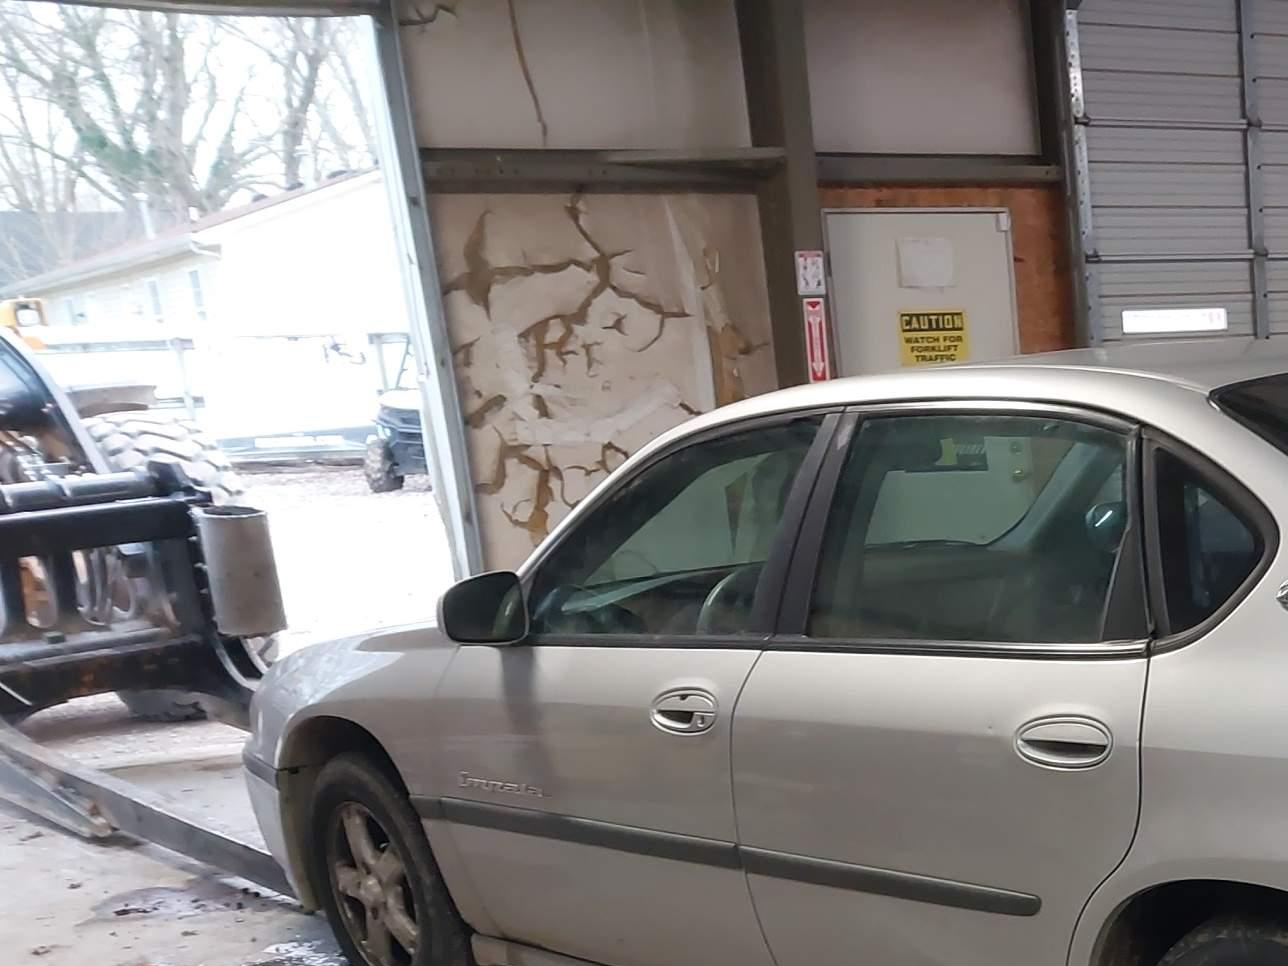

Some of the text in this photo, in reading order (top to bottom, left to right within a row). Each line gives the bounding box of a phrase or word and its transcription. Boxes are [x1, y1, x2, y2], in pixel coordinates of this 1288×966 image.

[902, 314, 962, 329] CAUTION
[904, 335, 962, 344] WATCH FOR
[910, 344, 958, 353] FORKLIFT
[915, 353, 956, 362] TRAFFIC
